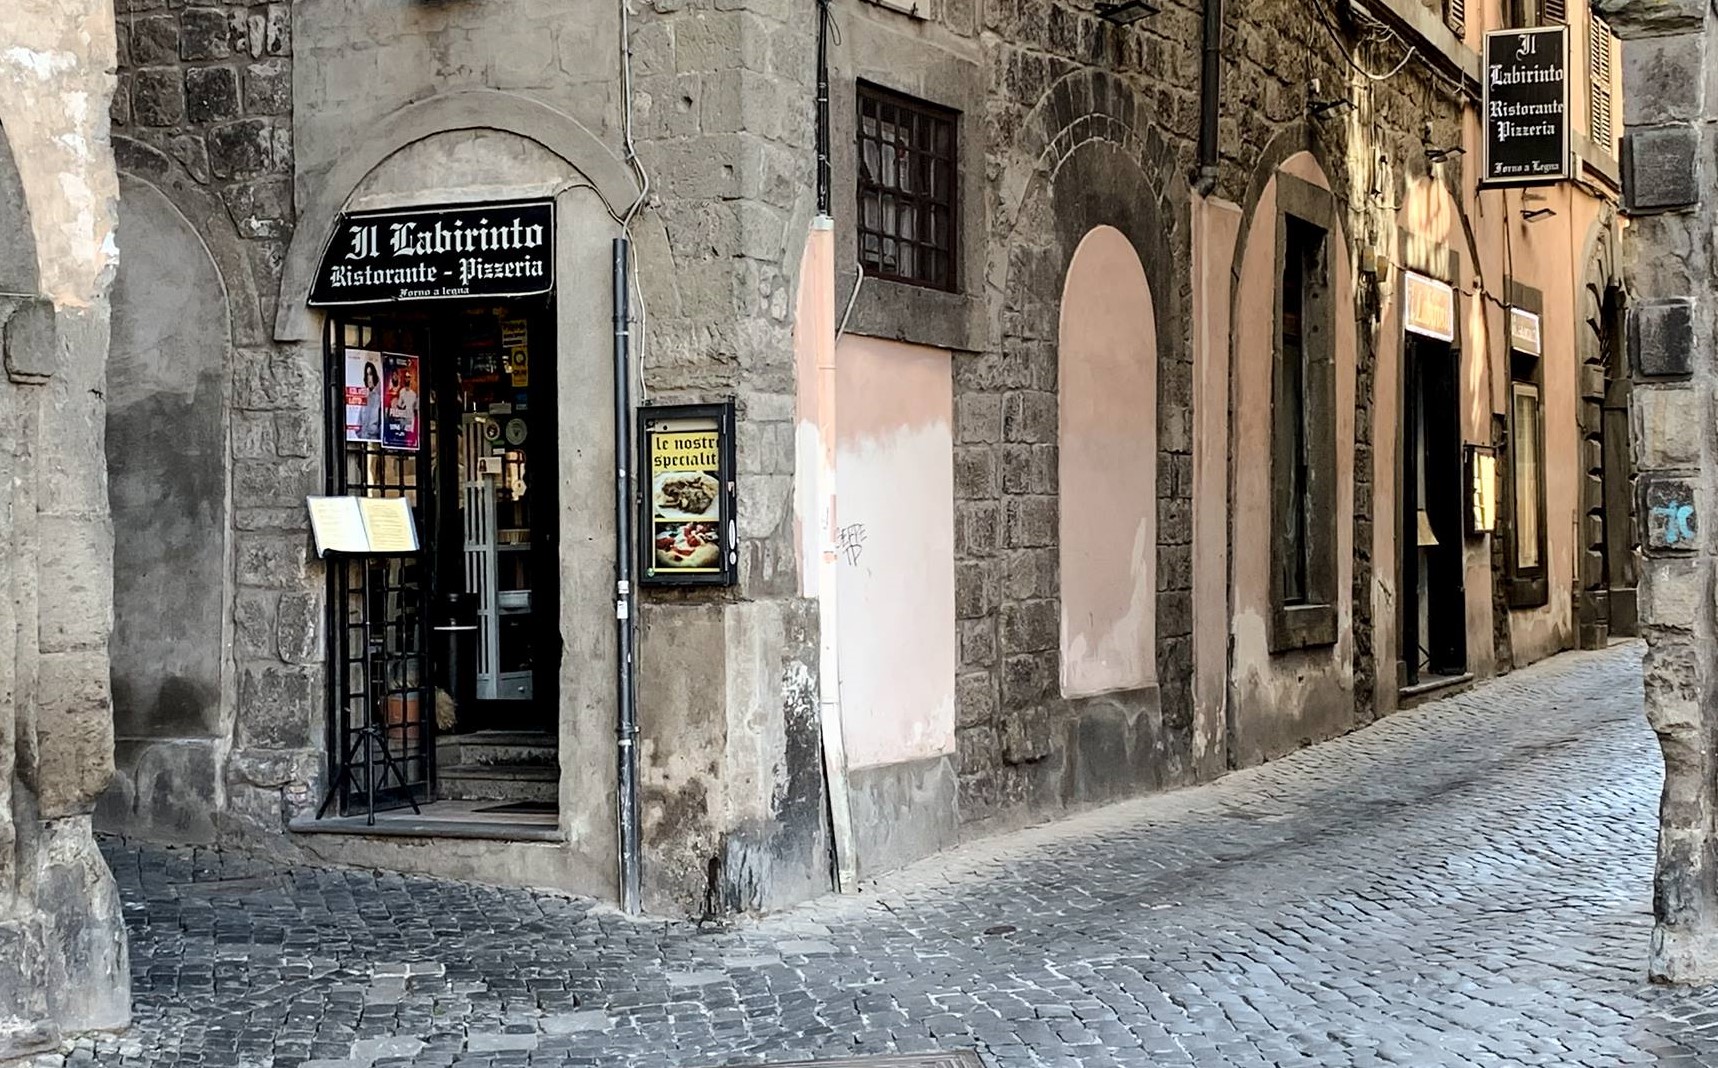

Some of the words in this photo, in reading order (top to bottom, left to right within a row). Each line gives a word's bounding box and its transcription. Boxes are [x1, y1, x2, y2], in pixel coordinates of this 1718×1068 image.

[1516, 34, 1536, 61] Il
[1489, 64, 1563, 92] Labirinto
[1489, 99, 1564, 121] Ristorante
[1497, 121, 1555, 142] Pizzeria
[1493, 162, 1522, 174] Forno
[1524, 164, 1530, 172] a
[1531, 160, 1559, 174] Legna
[345, 224, 381, 260] Il
[390, 217, 544, 257] Labirinto
[330, 262, 438, 287] Ristorante
[458, 255, 544, 286] Pizzeria
[399, 288, 431, 298] Forno
[442, 286, 470, 297] legna
[656, 437, 669, 451] le
[654, 453, 720, 469] specialit
